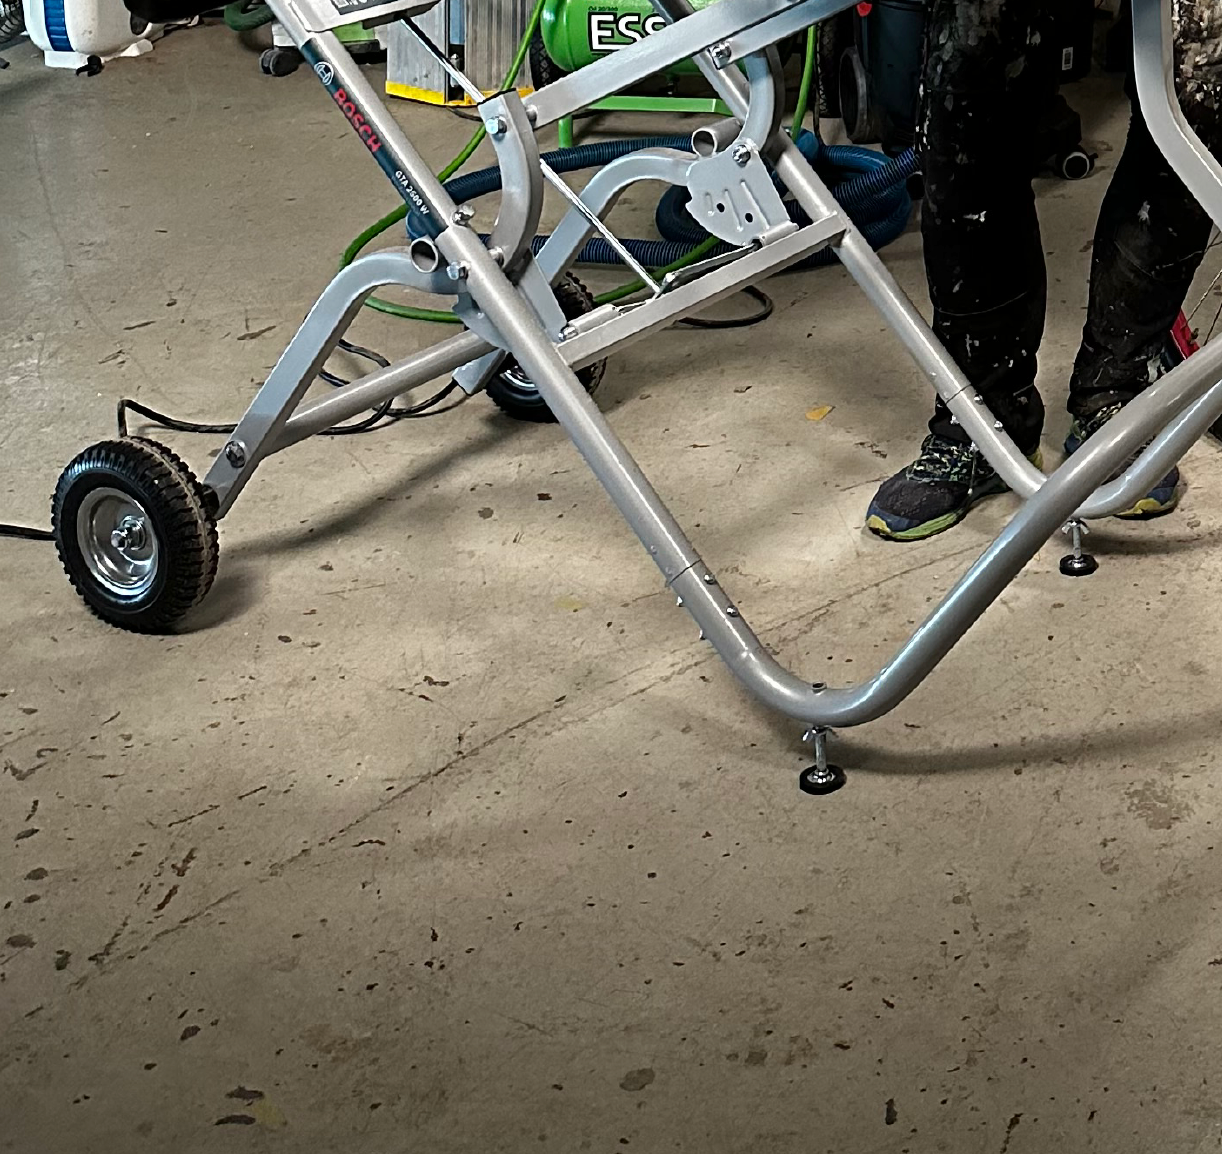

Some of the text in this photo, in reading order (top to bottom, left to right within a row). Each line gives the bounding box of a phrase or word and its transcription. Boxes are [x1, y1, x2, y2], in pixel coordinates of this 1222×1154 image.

[333, 88, 383, 153] BOSCH
[395, 170, 430, 215] GTA 2600 W
